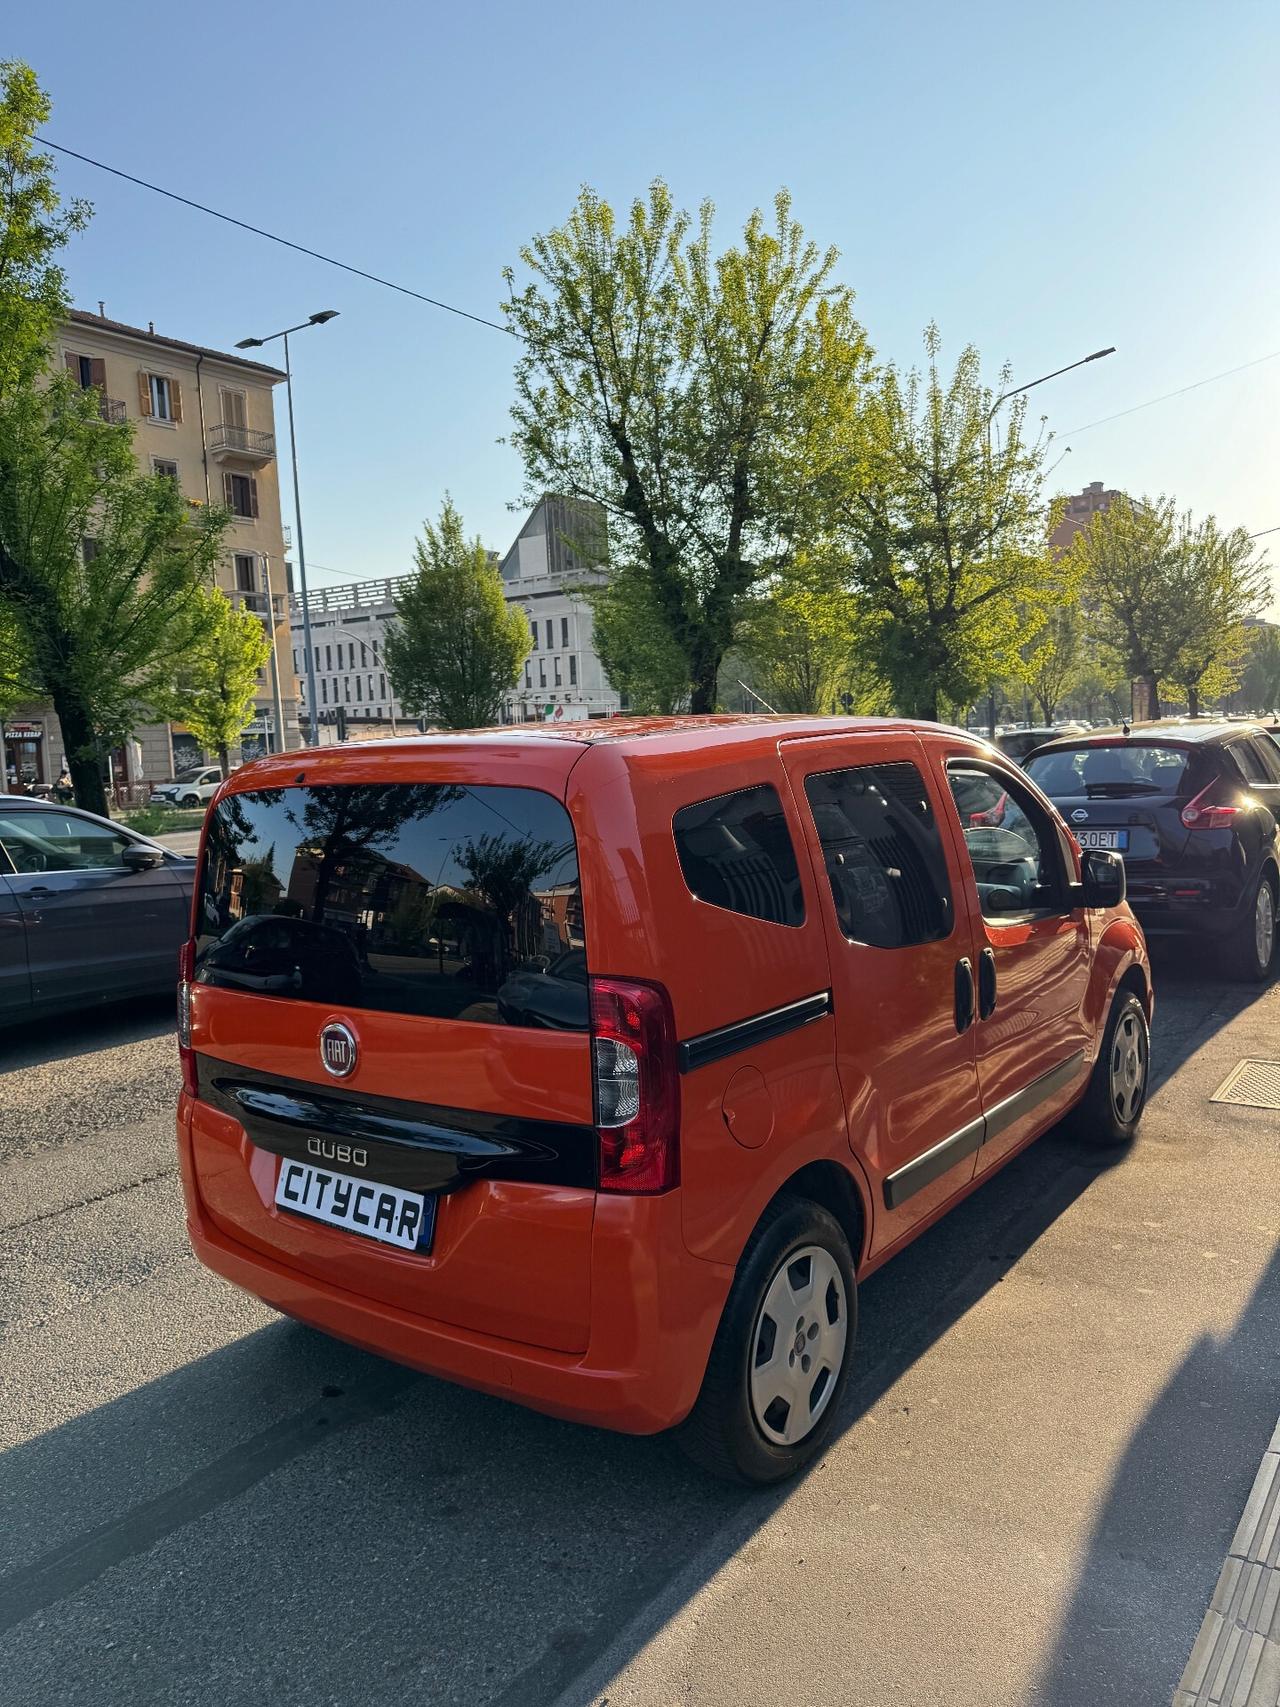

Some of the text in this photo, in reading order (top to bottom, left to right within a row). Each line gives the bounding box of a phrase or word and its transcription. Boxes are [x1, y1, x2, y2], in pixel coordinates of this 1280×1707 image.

[327, 1039, 346, 1063] FIAT
[307, 1136, 367, 1167] QUBO
[284, 1165, 420, 1241] CITYCAR
